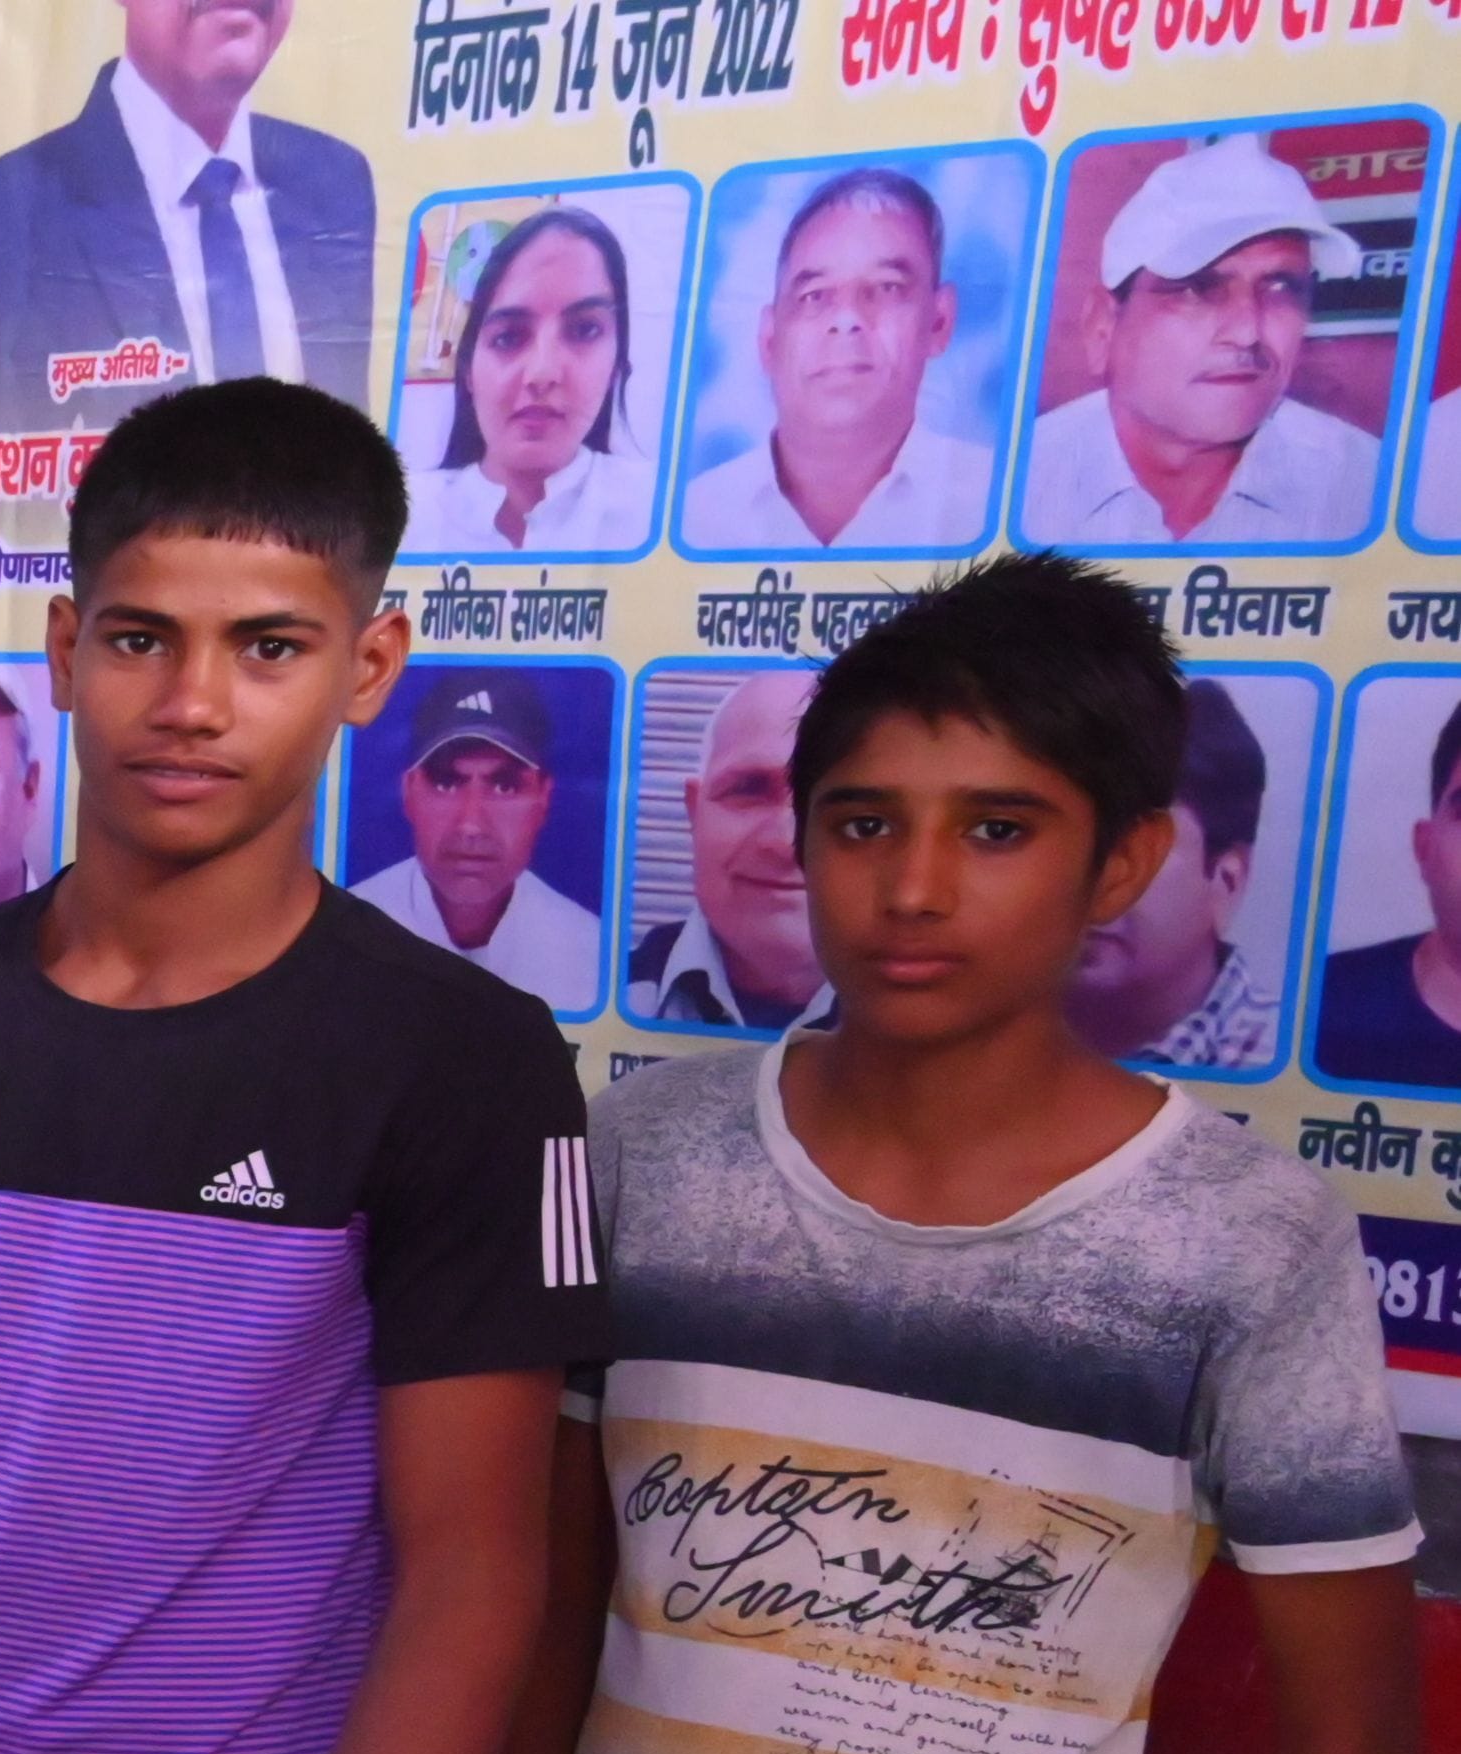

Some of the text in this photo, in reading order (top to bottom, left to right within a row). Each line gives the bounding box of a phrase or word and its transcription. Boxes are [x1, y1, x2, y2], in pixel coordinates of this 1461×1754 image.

[554, 3, 600, 113] 14
[611, 0, 701, 168] जून
[702, 0, 798, 98] 2022
[52, 356, 97, 397] मुख्य
[100, 342, 160, 380] अतिथि
[421, 566, 607, 642] मोनिका सांगवान
[1183, 565, 1331, 637] सिवाच
[1298, 1101, 1422, 1177] नवीन
[200, 1182, 286, 1210] adidas
[878, 1627, 928, 1646] hard
[940, 1643, 980, 1659] and
[792, 1681, 897, 1712] surround
[905, 1711, 997, 1743] yourself
[1010, 1732, 1054, 1745] with
[798, 1660, 1008, 1720] and keep learning
[1014, 1682, 1033, 1696] to
[776, 1725, 822, 1750] stay
[784, 1706, 849, 1725] warm
[863, 1721, 906, 1737] and
